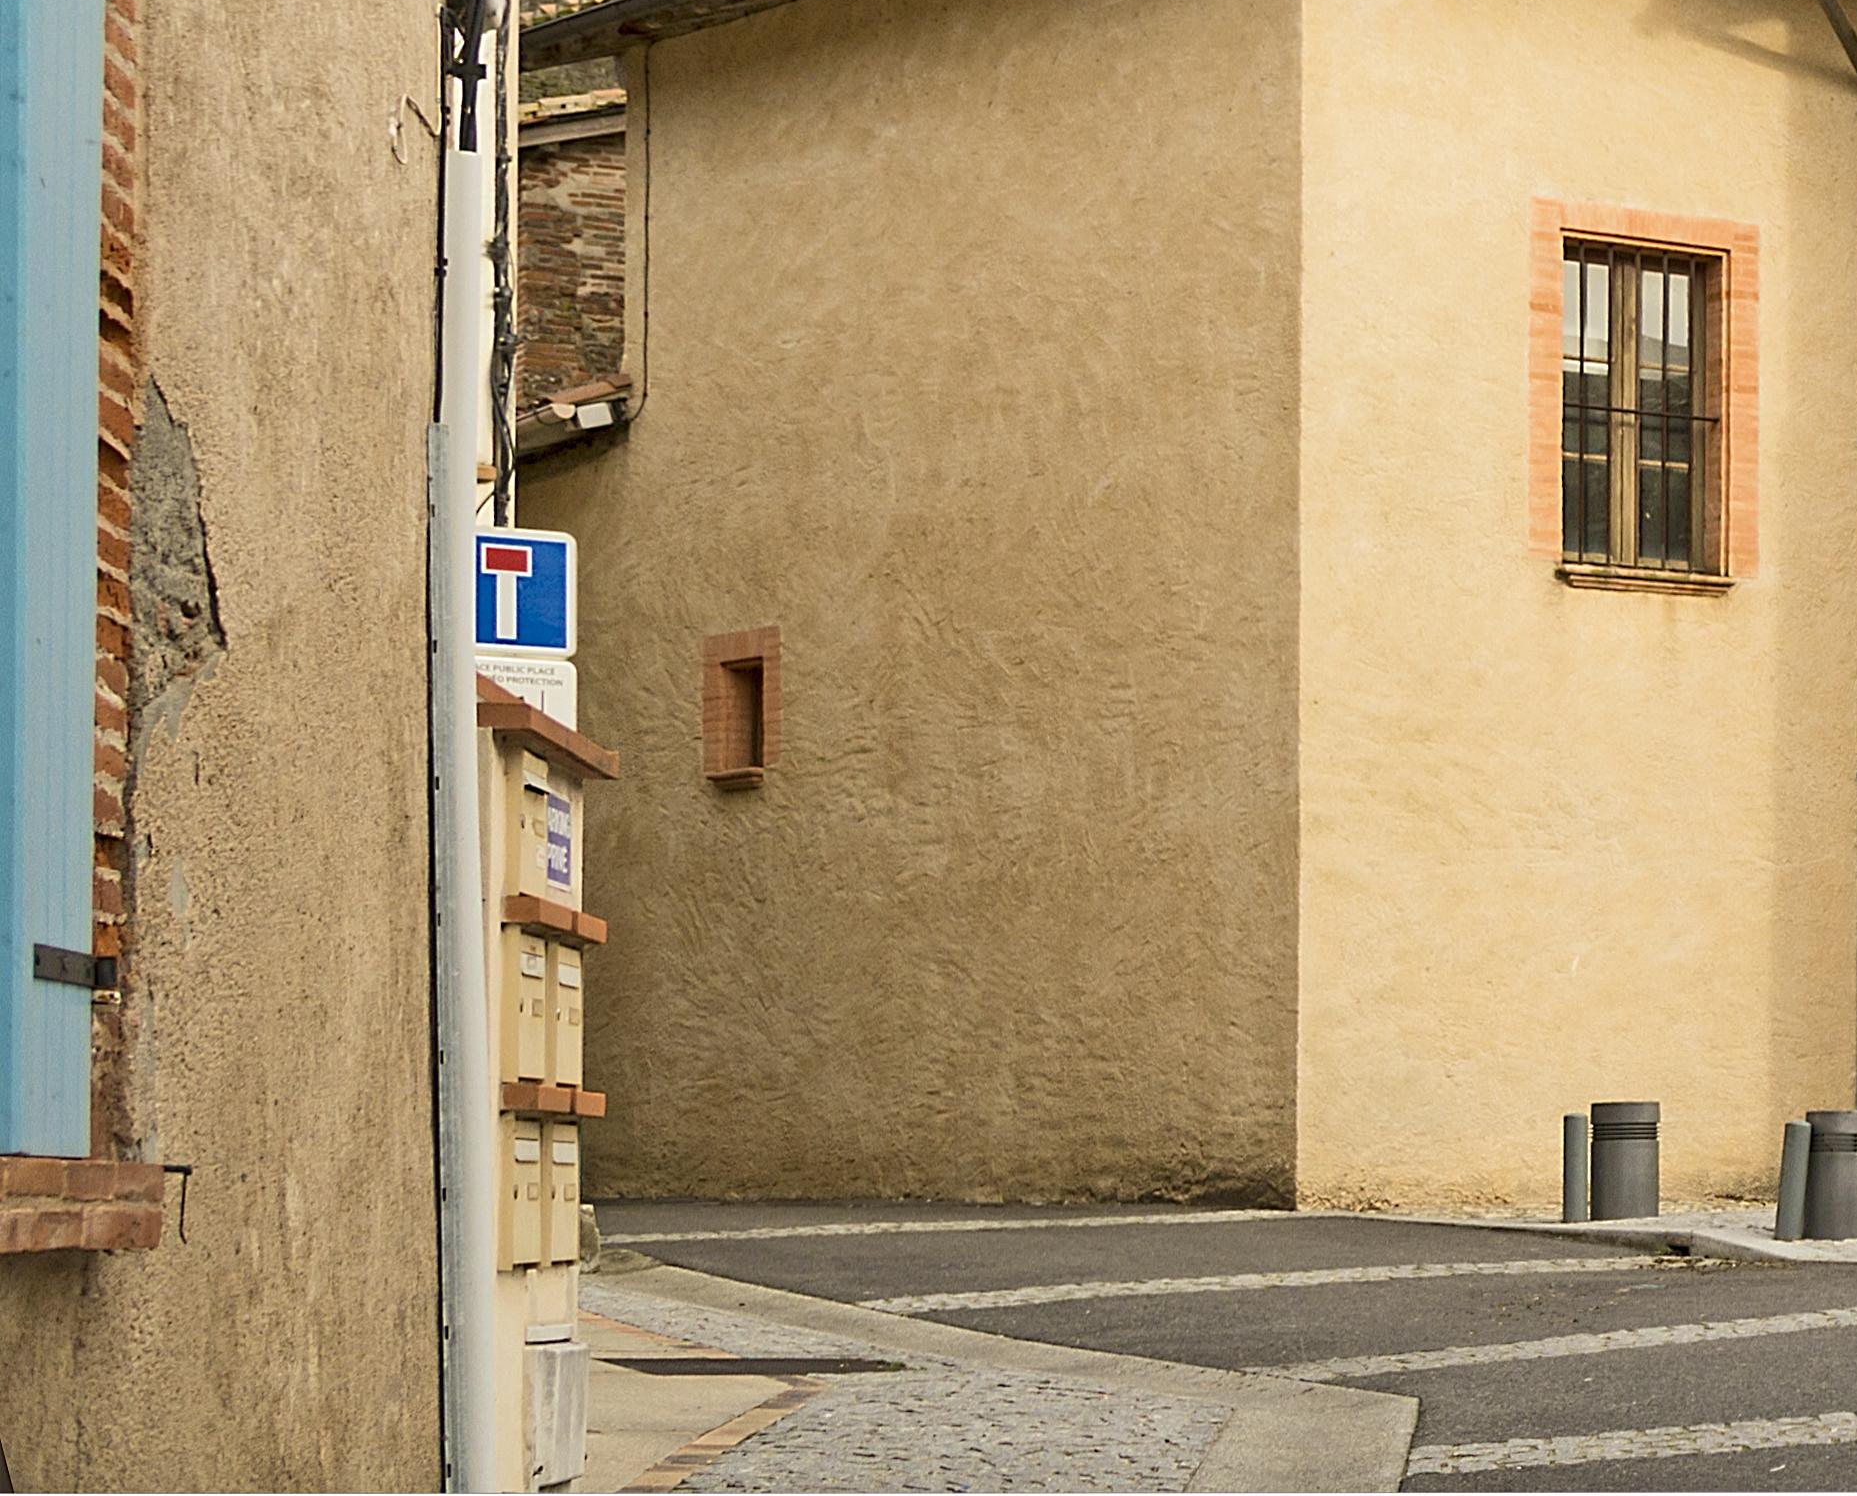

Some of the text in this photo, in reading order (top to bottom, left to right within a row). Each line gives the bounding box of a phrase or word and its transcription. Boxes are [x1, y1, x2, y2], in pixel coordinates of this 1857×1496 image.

[493, 664, 527, 675] PUBLIC
[527, 667, 555, 676] PLACE
[506, 676, 564, 687] PROTECTION
